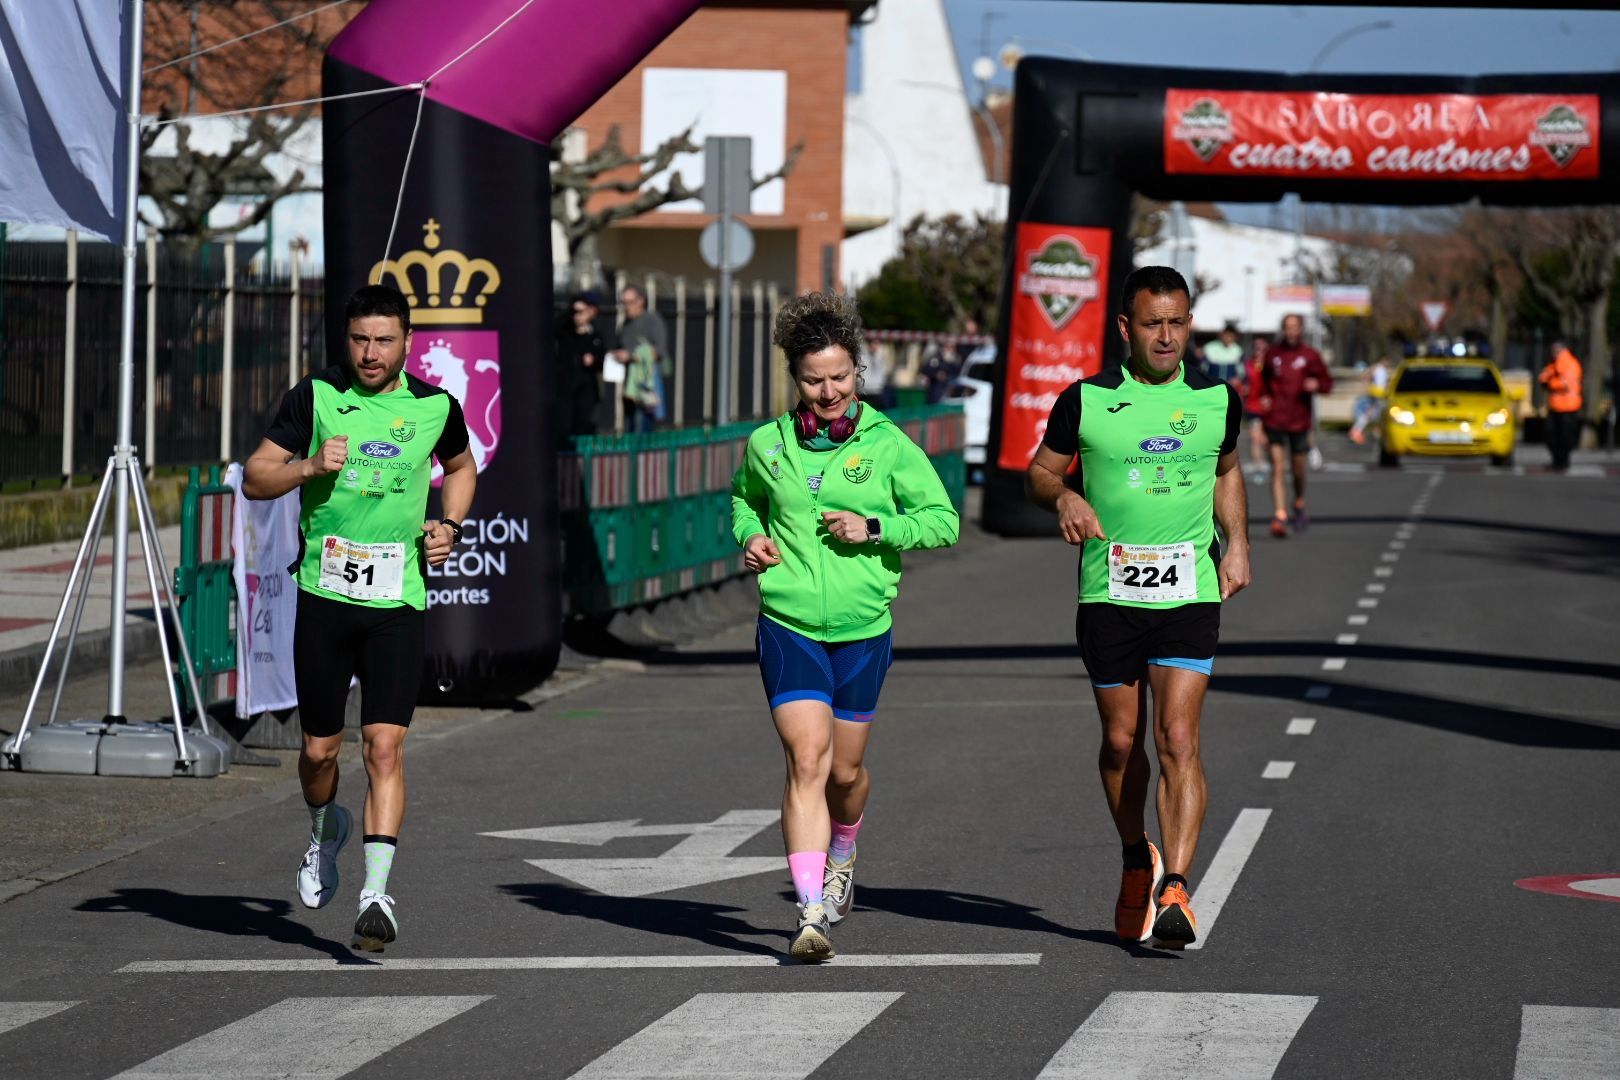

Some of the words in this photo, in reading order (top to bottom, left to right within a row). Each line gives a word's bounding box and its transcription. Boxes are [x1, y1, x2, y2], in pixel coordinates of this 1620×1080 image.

[1229, 137, 1353, 170] cuatro
[1366, 138, 1531, 172] cantones
[366, 443, 393, 456] Ford
[1147, 439, 1174, 451] Ford
[1124, 455, 1197, 465] AUTOPALACIOS
[461, 512, 529, 545] CIÓN
[343, 560, 374, 586] 51
[1123, 565, 1179, 588] 224
[427, 586, 490, 610] portes
